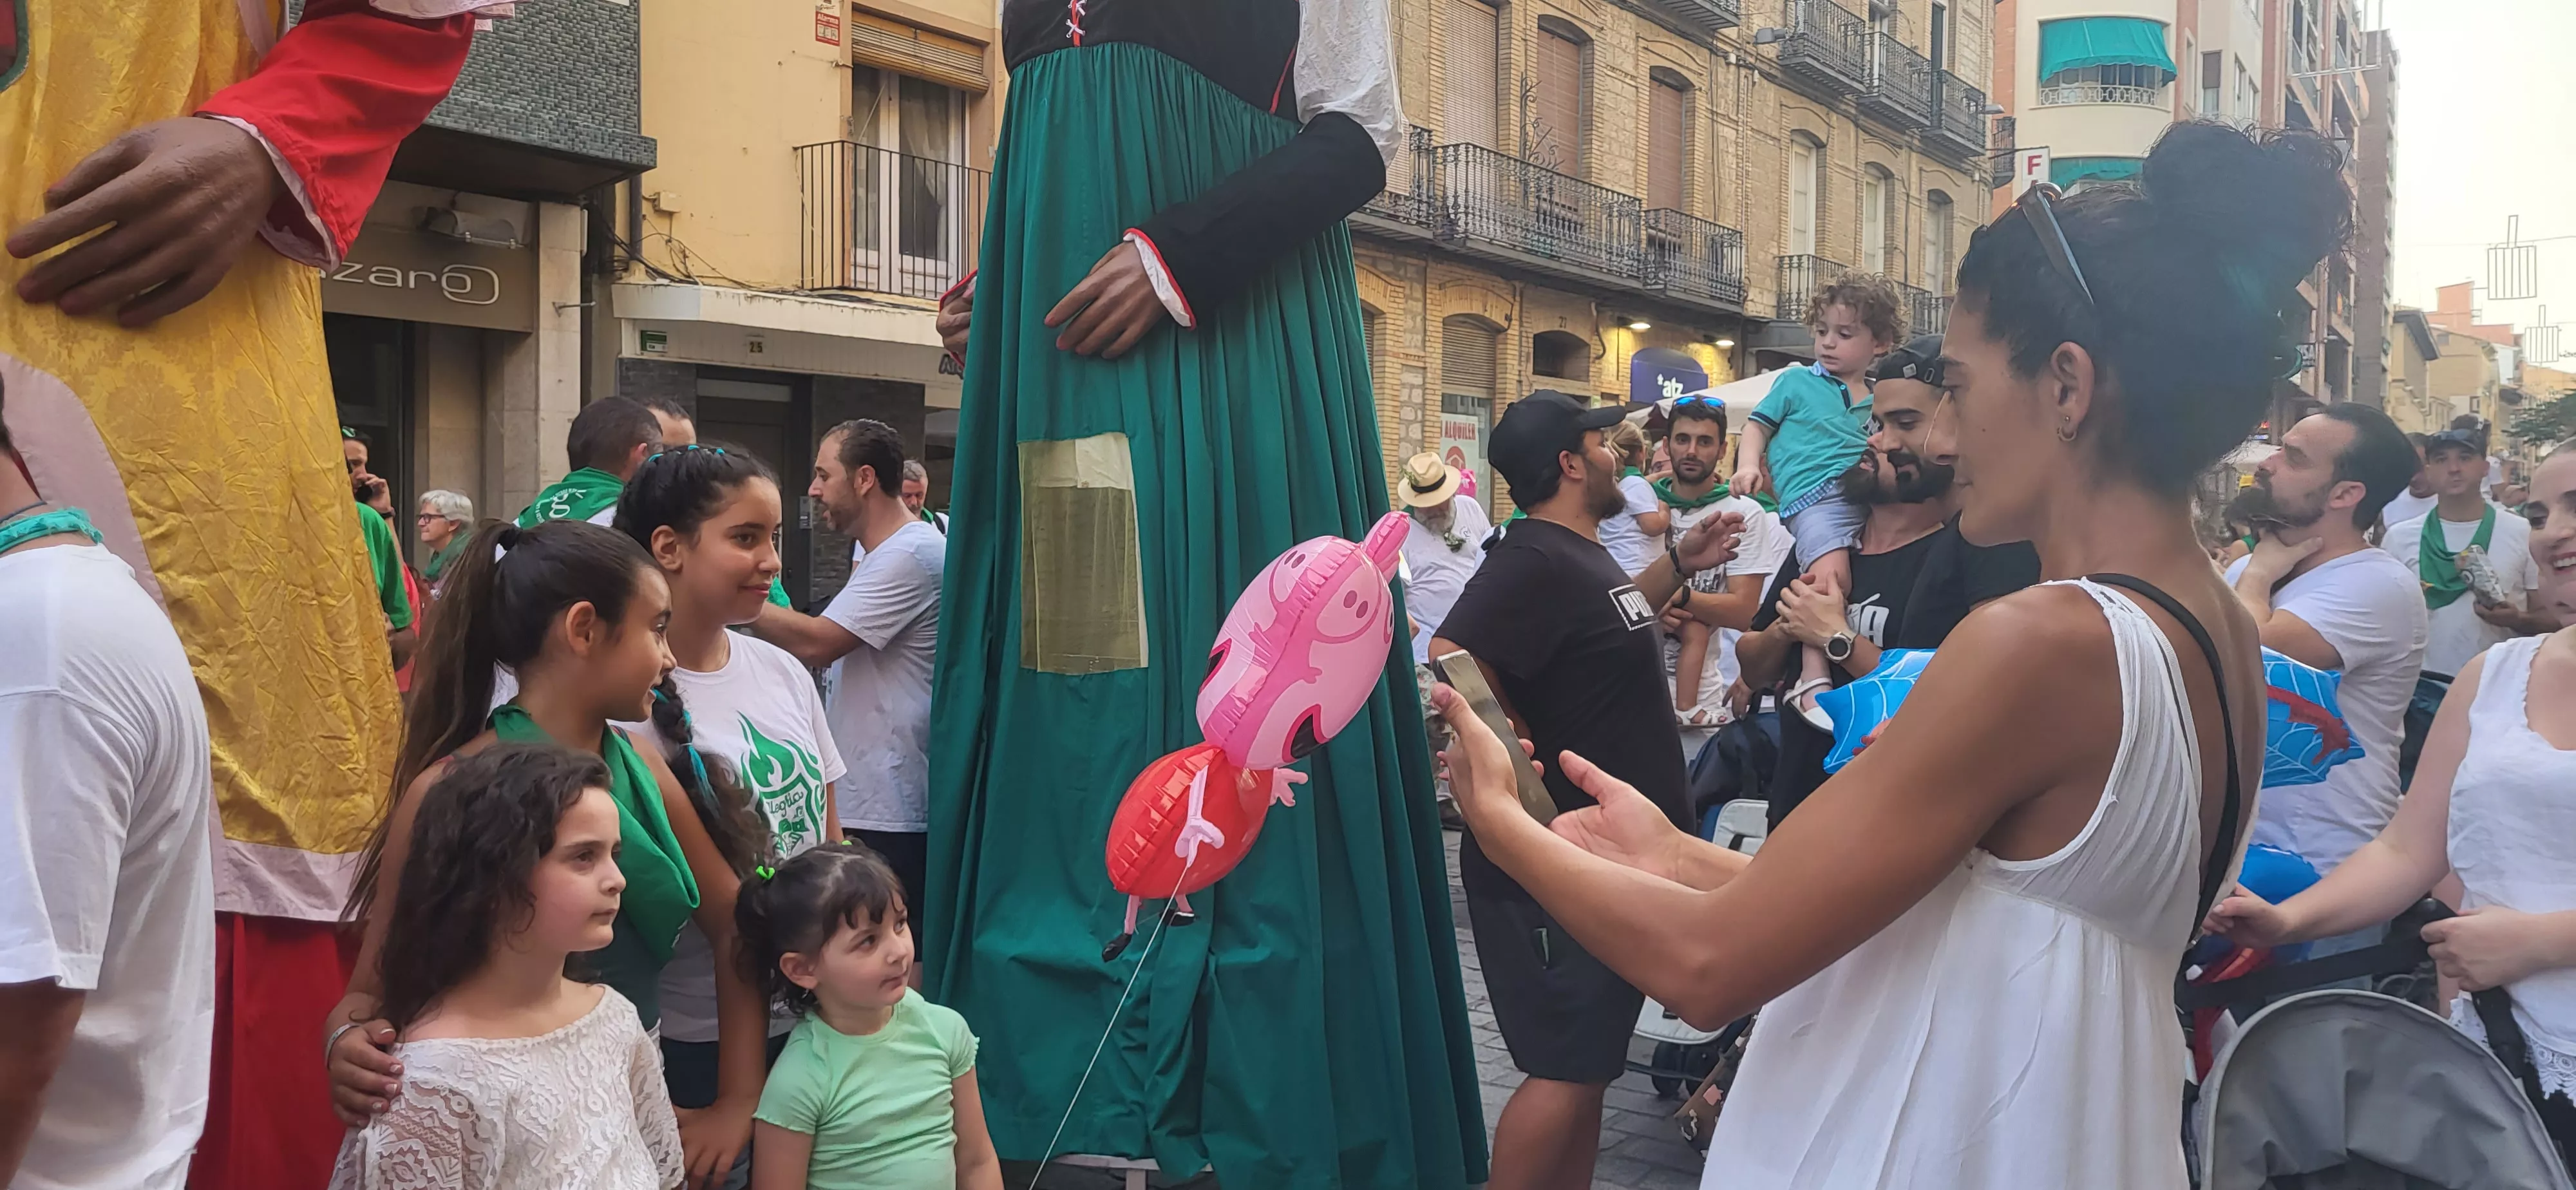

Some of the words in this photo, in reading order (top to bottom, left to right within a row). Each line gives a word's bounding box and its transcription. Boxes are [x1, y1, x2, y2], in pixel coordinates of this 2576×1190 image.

[2027, 155, 2042, 185] F
[319, 261, 499, 305] zaro
[749, 341, 763, 353] 25
[1444, 420, 1476, 441] ALQUILER
